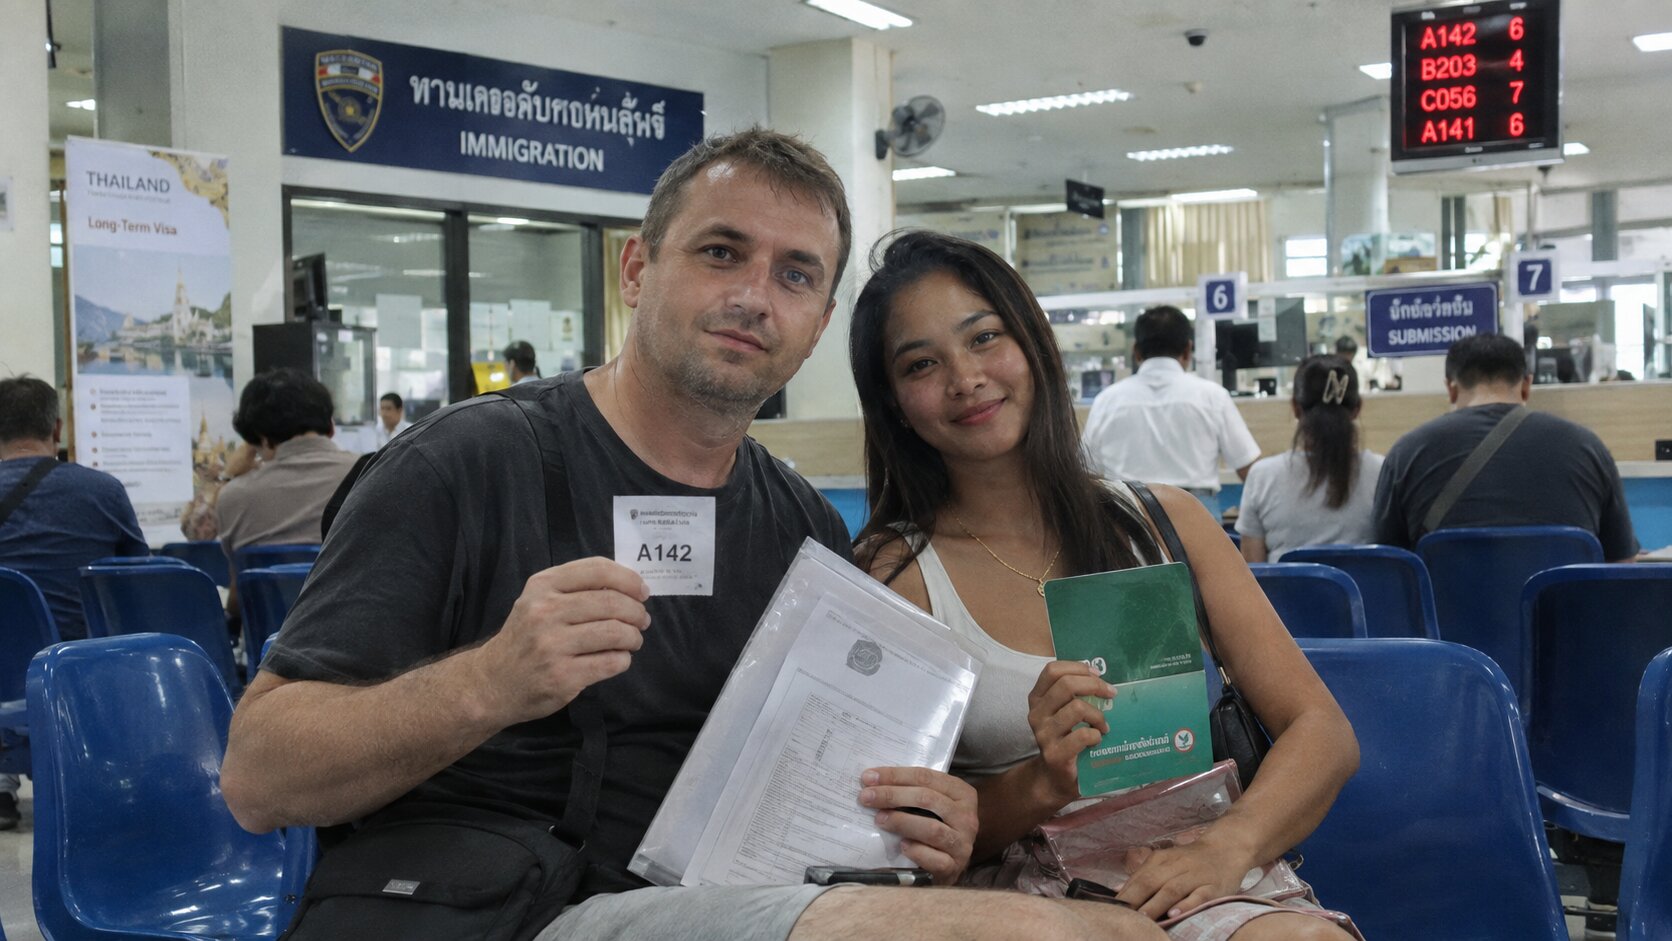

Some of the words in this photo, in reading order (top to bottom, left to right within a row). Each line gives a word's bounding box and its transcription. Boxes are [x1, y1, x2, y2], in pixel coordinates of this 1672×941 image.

[1420, 22, 1477, 50] A142
[1509, 16, 1524, 41] 6
[1421, 53, 1477, 81] B203
[1509, 49, 1524, 72] 4
[1421, 85, 1477, 112] C056
[1509, 80, 1524, 104] 7
[1421, 116, 1475, 143] A141
[1509, 112, 1525, 137] 6
[460, 130, 604, 172] IMMIGRATION
[86, 171, 170, 193] THAILAND
[88, 216, 150, 233] Long-Term
[154, 222, 177, 235] Visa
[1527, 264, 1543, 291] 7
[1213, 284, 1228, 309] 6
[1388, 325, 1476, 345] SUBMISSION
[637, 543, 692, 562] A142
